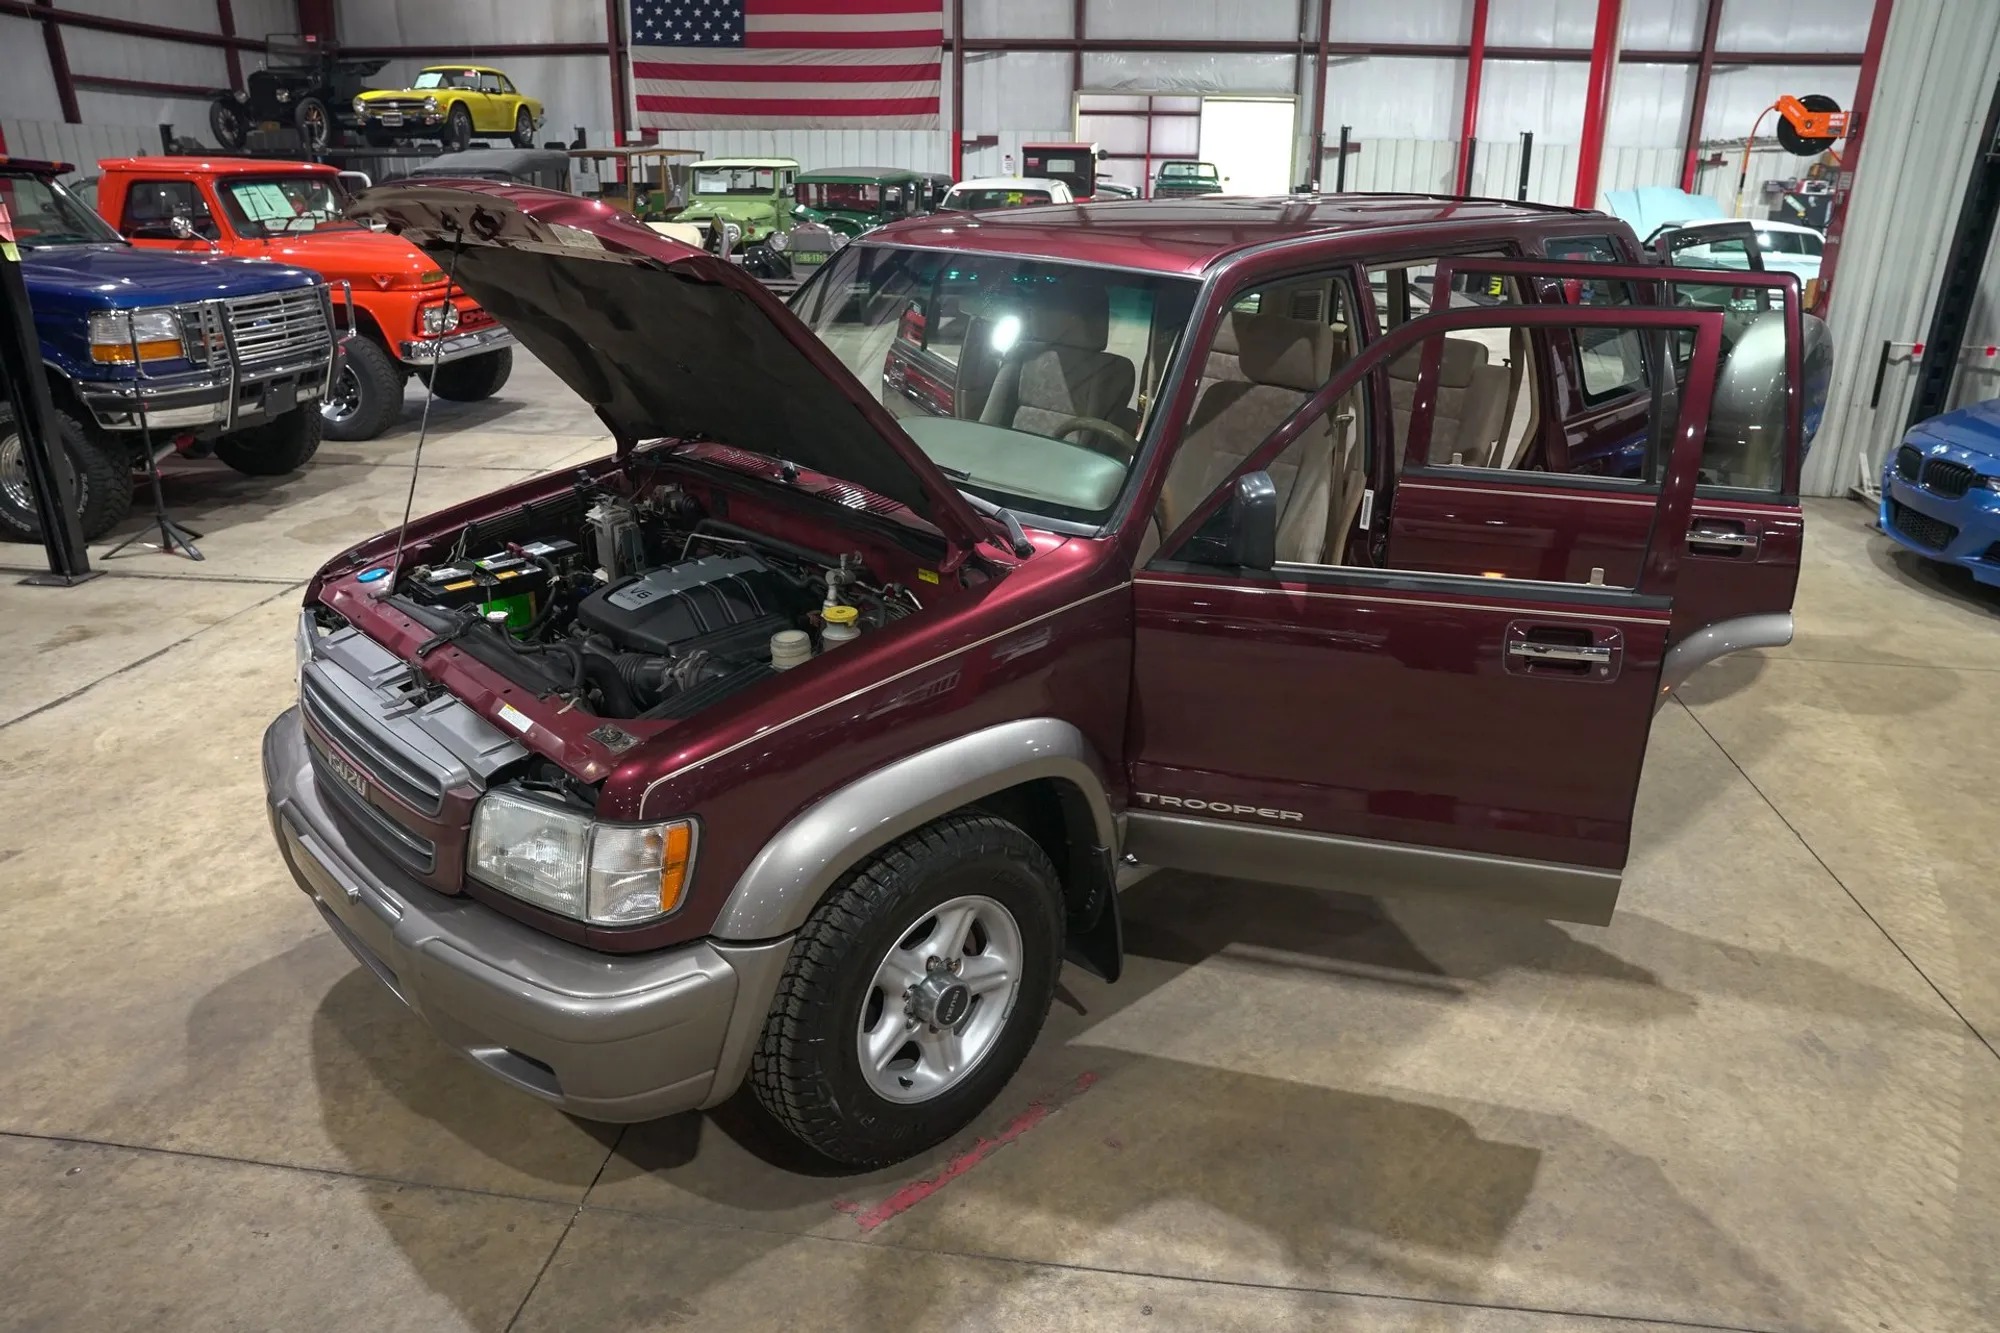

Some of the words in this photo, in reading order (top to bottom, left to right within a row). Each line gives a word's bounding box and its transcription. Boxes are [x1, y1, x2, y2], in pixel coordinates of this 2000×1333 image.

[630, 586, 653, 599] V6
[328, 749, 367, 796] ISUZU
[1136, 792, 1303, 821] TROOPER
[945, 990, 960, 1021] ISUZU
